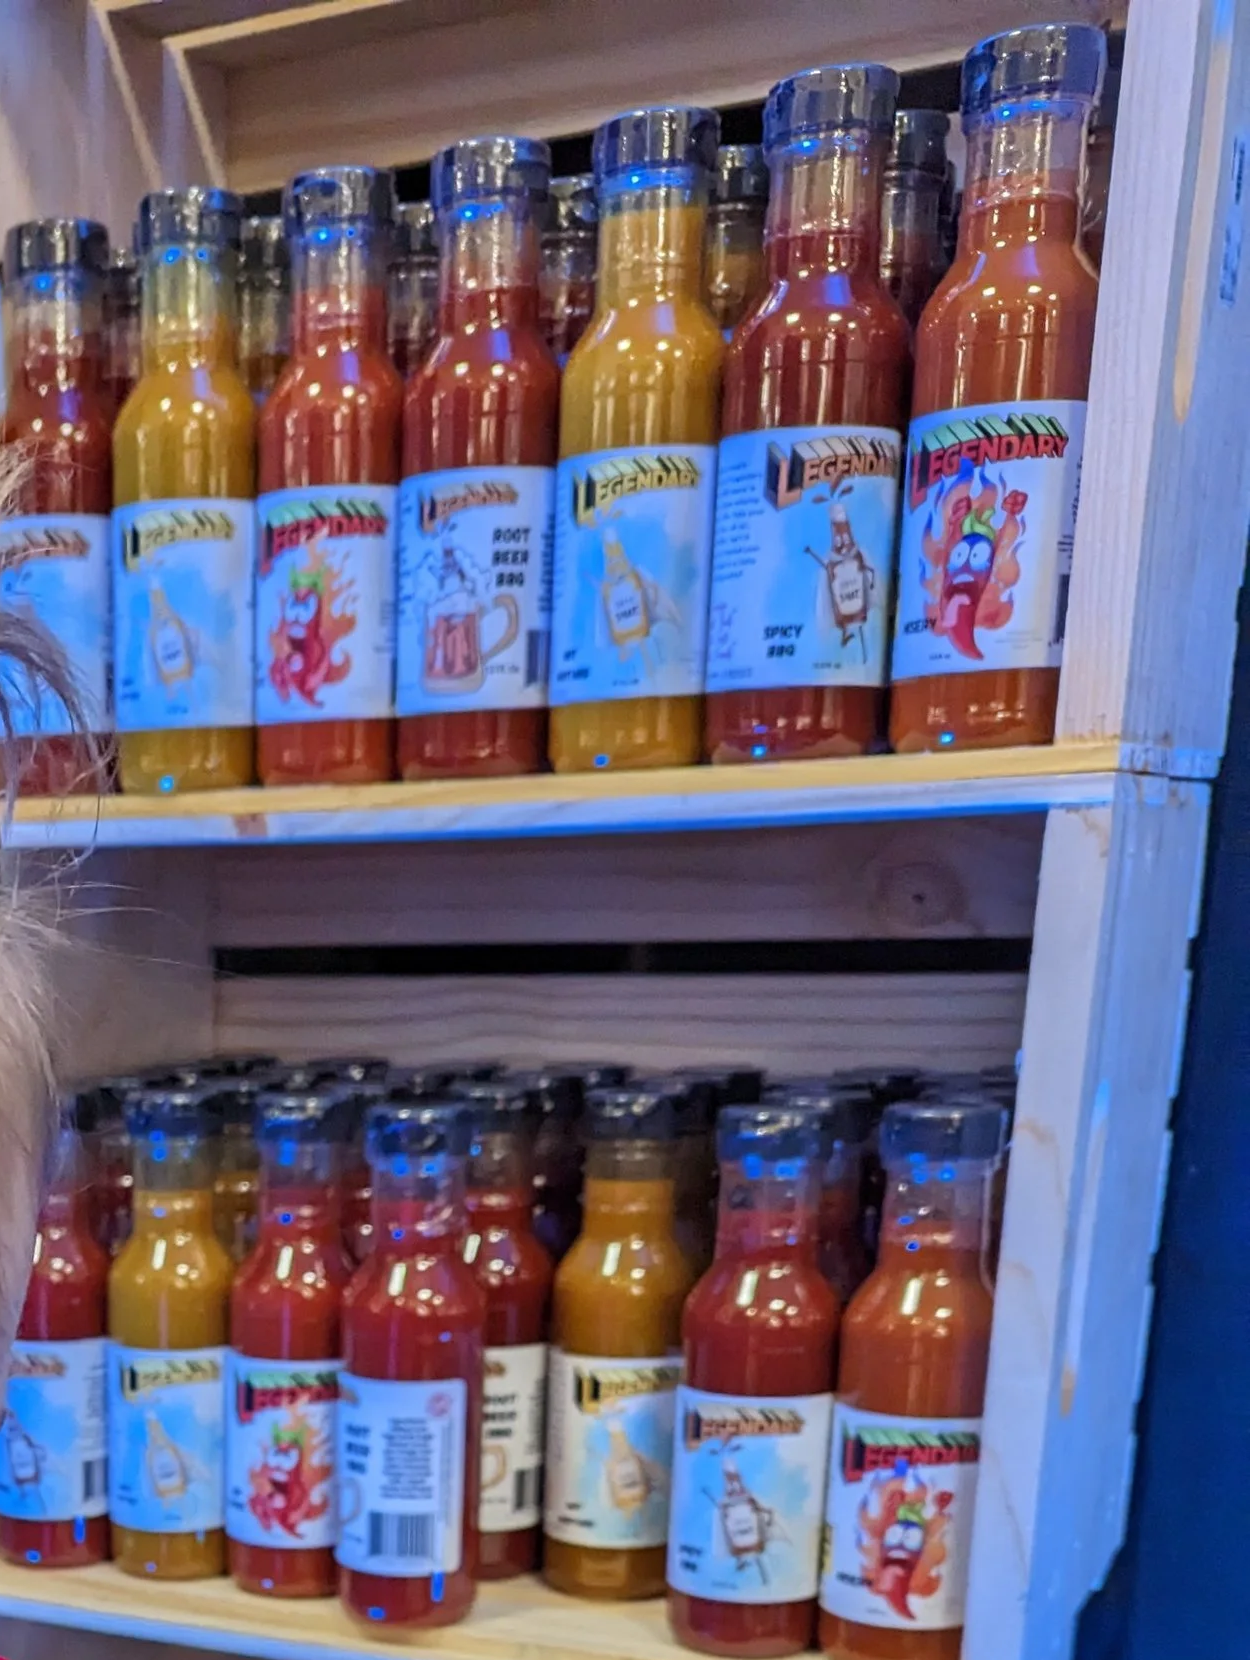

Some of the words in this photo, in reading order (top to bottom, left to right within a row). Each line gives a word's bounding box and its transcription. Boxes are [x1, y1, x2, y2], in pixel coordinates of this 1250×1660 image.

[909, 413, 1070, 514] LEGENDARY
[766, 436, 897, 511] LEGENDA
[492, 526, 531, 544] ROOT
[492, 550, 529, 566] BEER
[495, 571, 525, 588] BBQ
[763, 623, 803, 641] SPICY
[766, 645, 796, 659] BBQ
